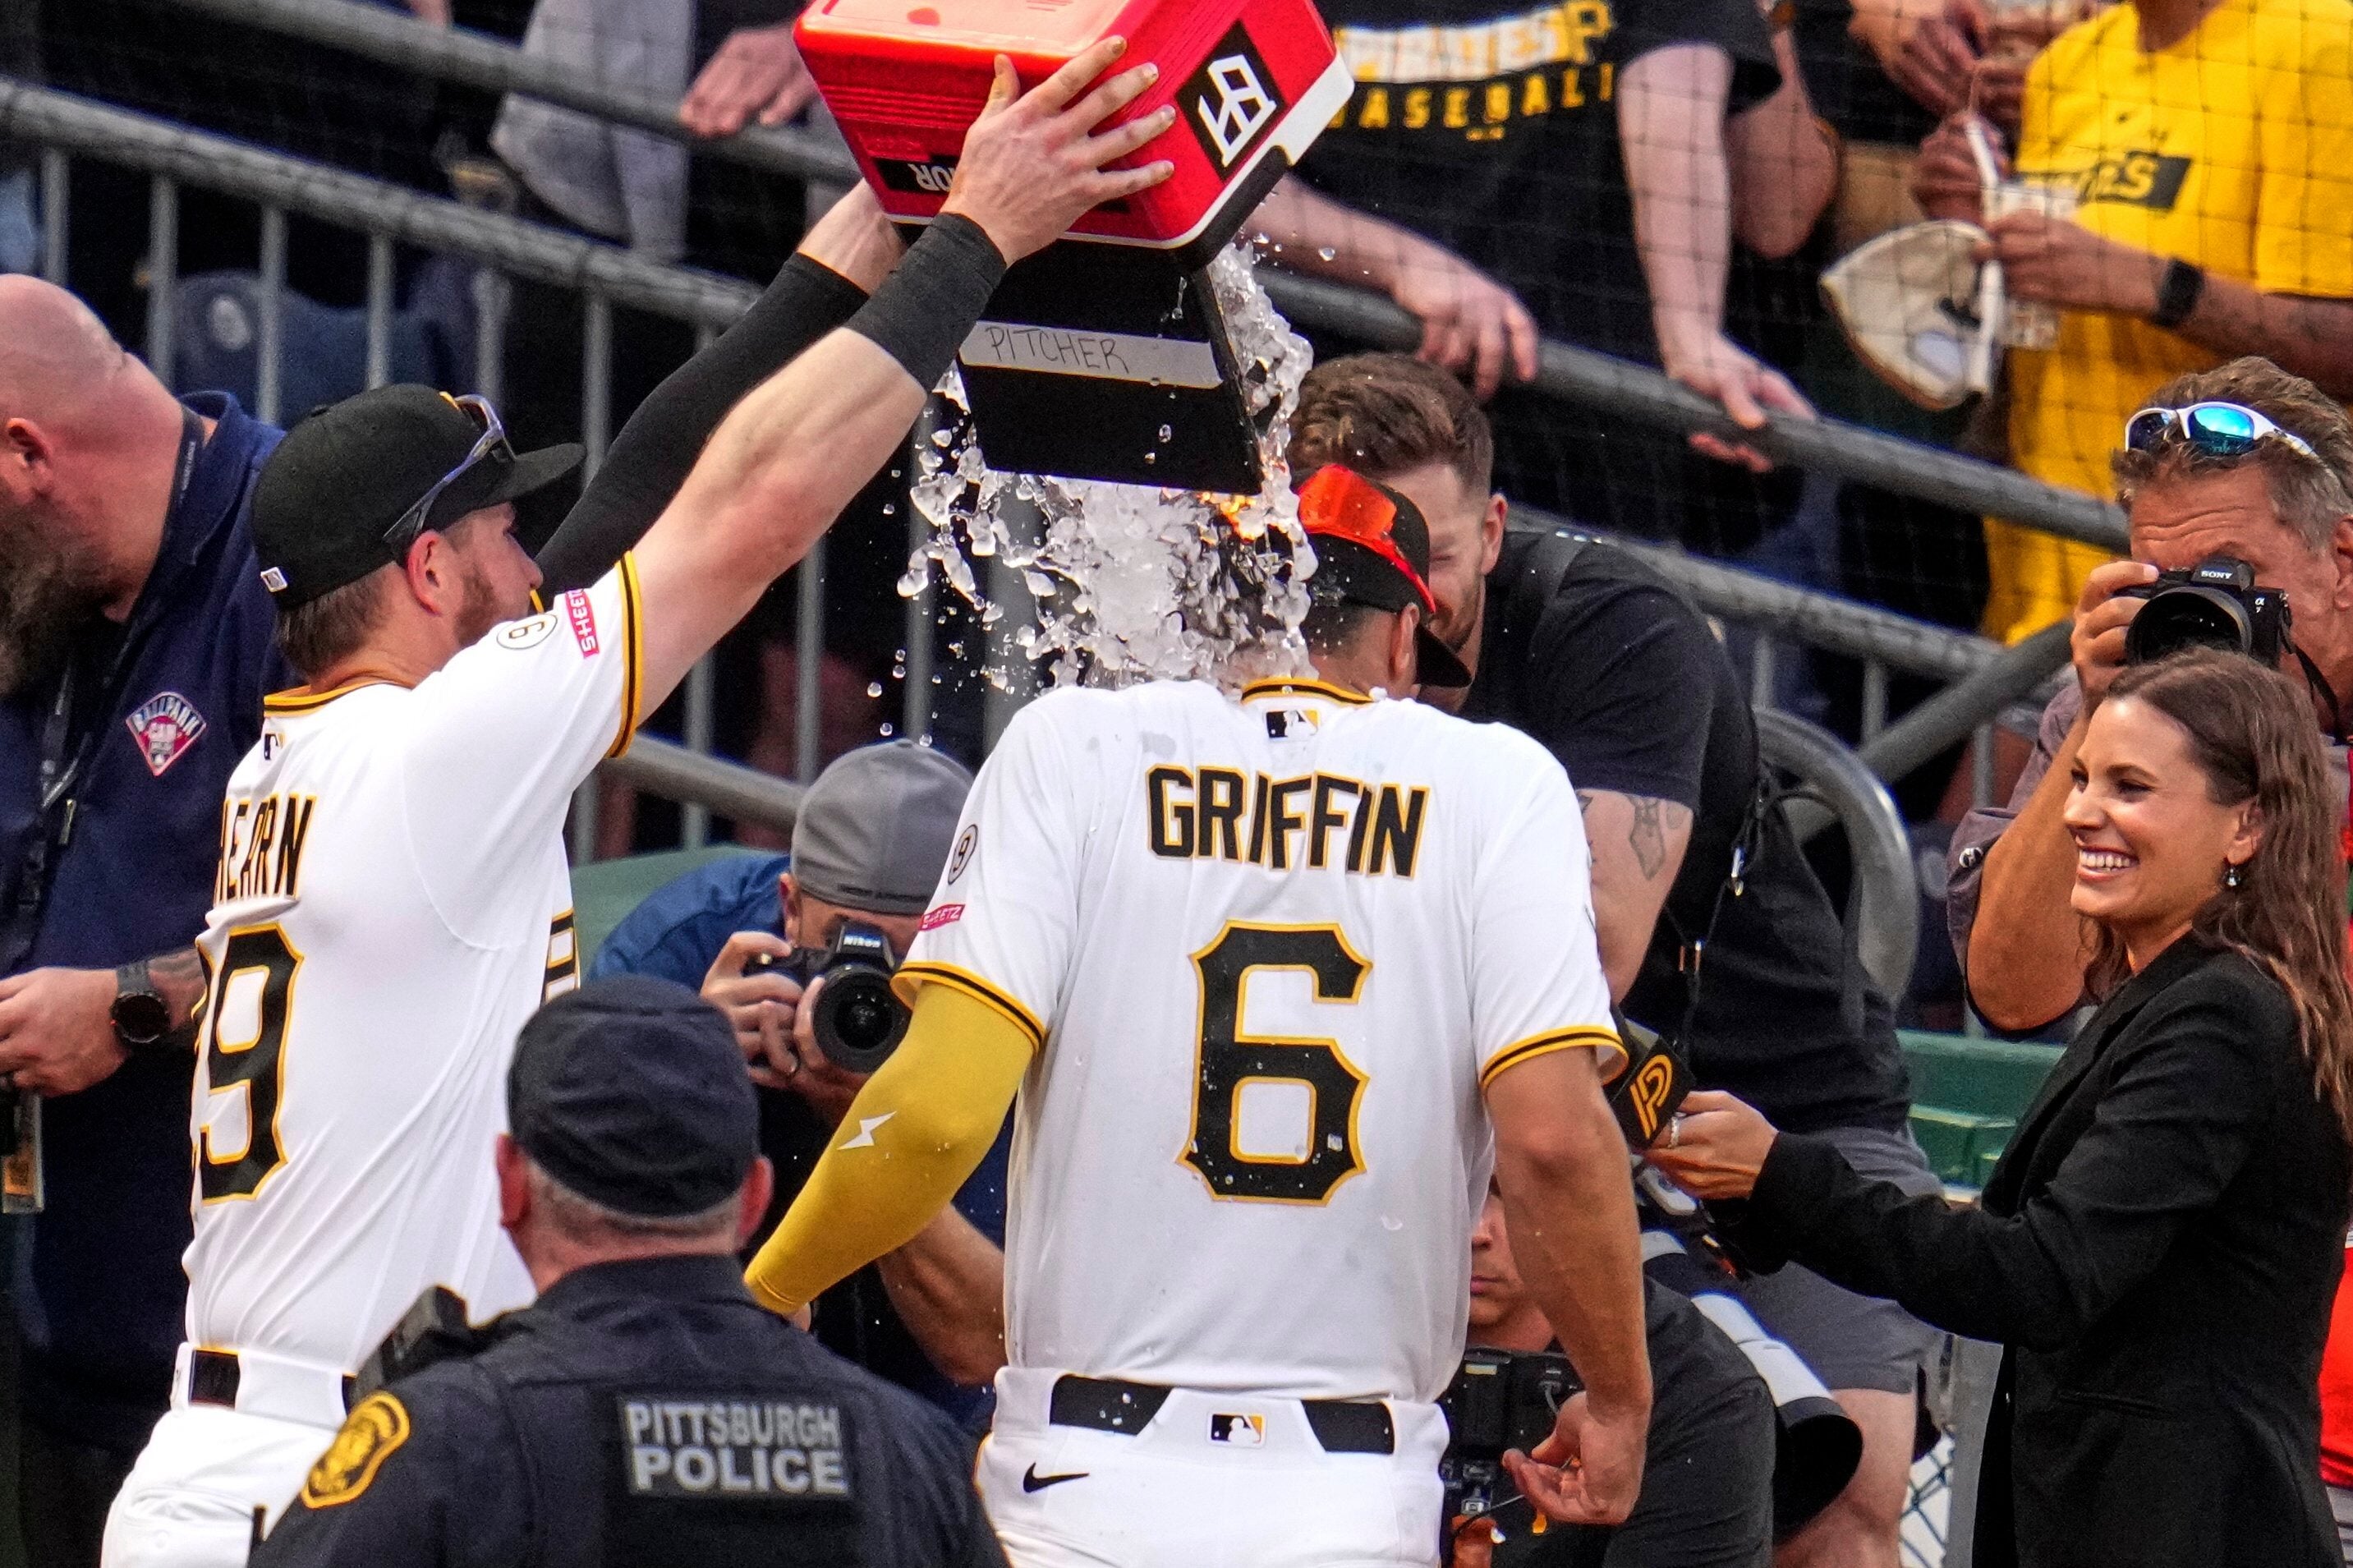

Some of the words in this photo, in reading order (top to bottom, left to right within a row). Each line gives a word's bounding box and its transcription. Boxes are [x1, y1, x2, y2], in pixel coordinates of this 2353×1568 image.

[986, 326, 1129, 374] PITCHER
[2200, 570, 2233, 579] SONY
[567, 589, 596, 653] SHEET
[1146, 763, 1432, 880] GRIFFIN
[953, 835, 972, 872] 9
[191, 921, 305, 1207] 9
[1175, 919, 1374, 1207] 6
[625, 1401, 843, 1448] PITTSBURGH
[632, 1445, 849, 1495] POLICE
